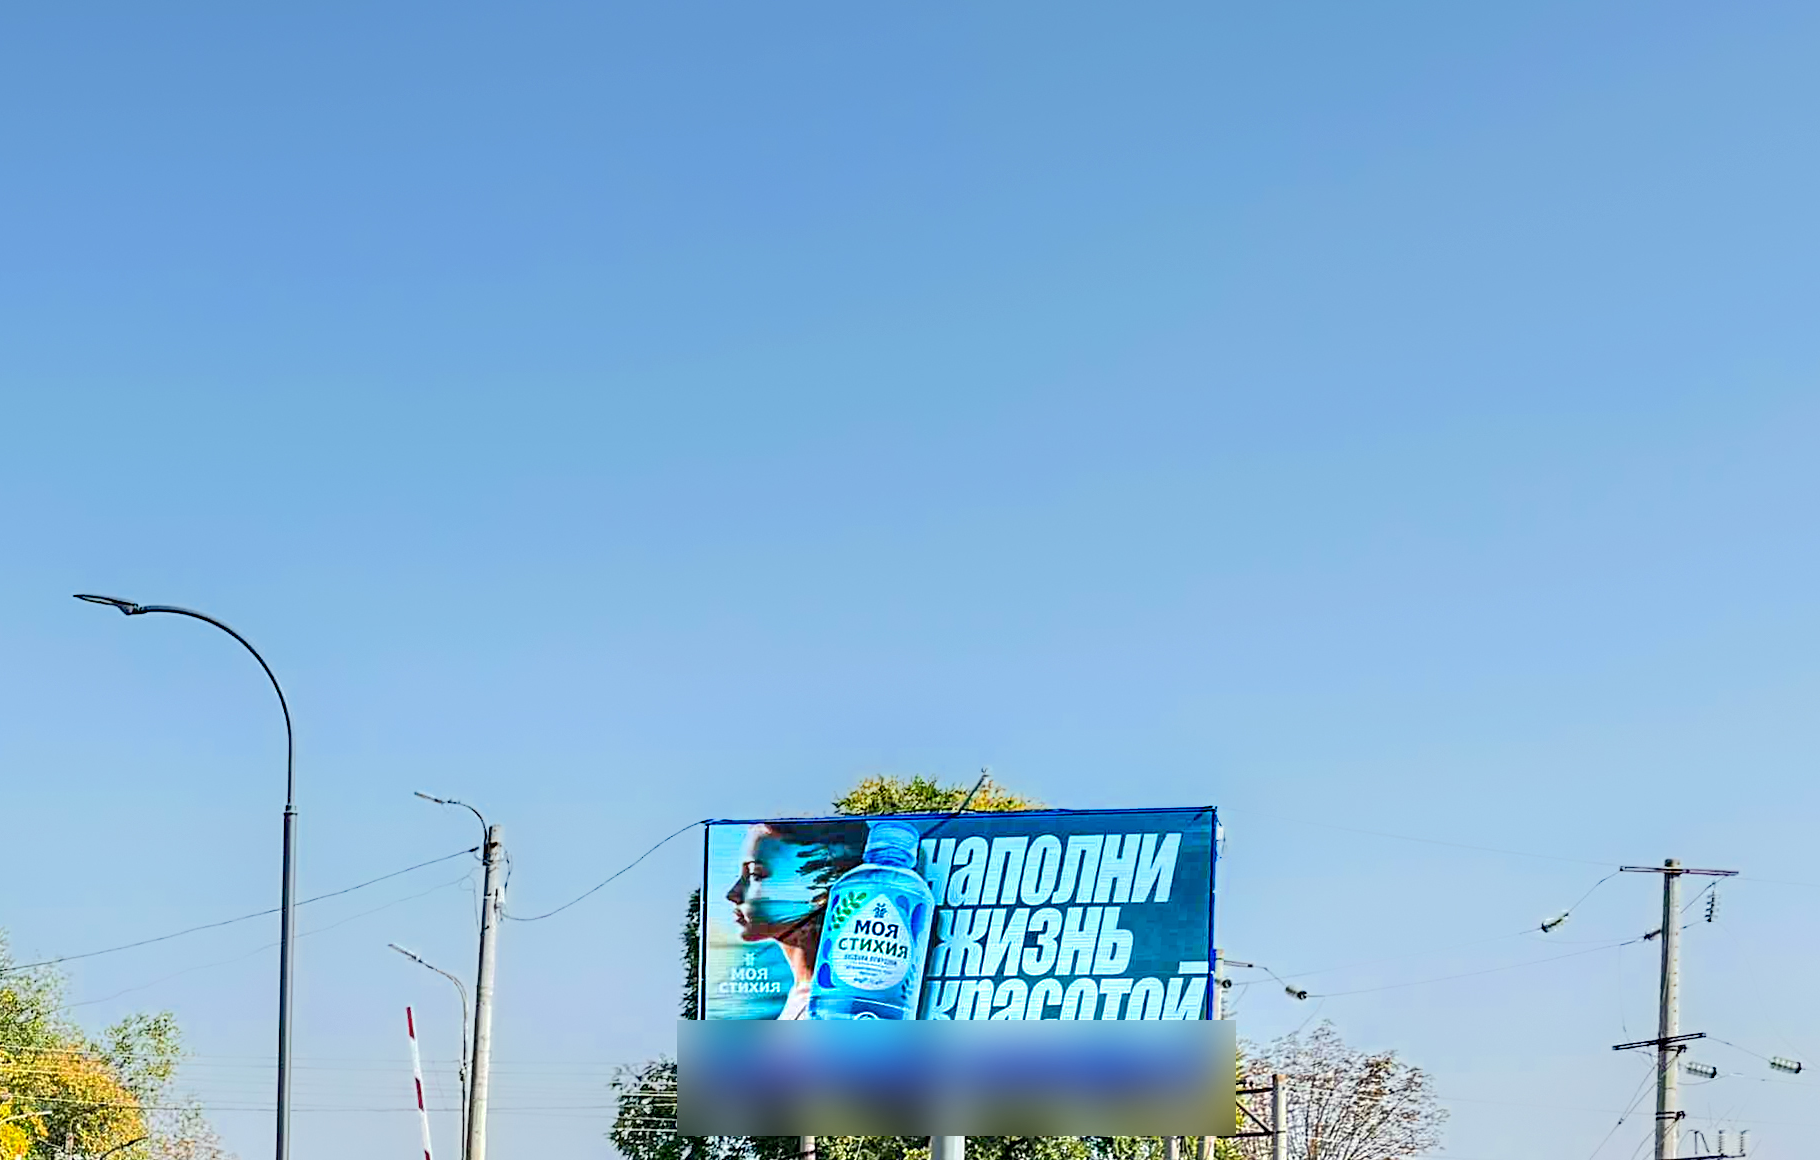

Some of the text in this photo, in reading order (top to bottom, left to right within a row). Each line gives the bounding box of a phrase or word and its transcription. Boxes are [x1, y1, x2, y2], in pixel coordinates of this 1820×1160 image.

[854, 920, 899, 939] МОЯ
[838, 937, 908, 959] СТИХИЯ
[730, 967, 768, 981] МОЯ
[719, 981, 781, 994] СТИХИЯ
